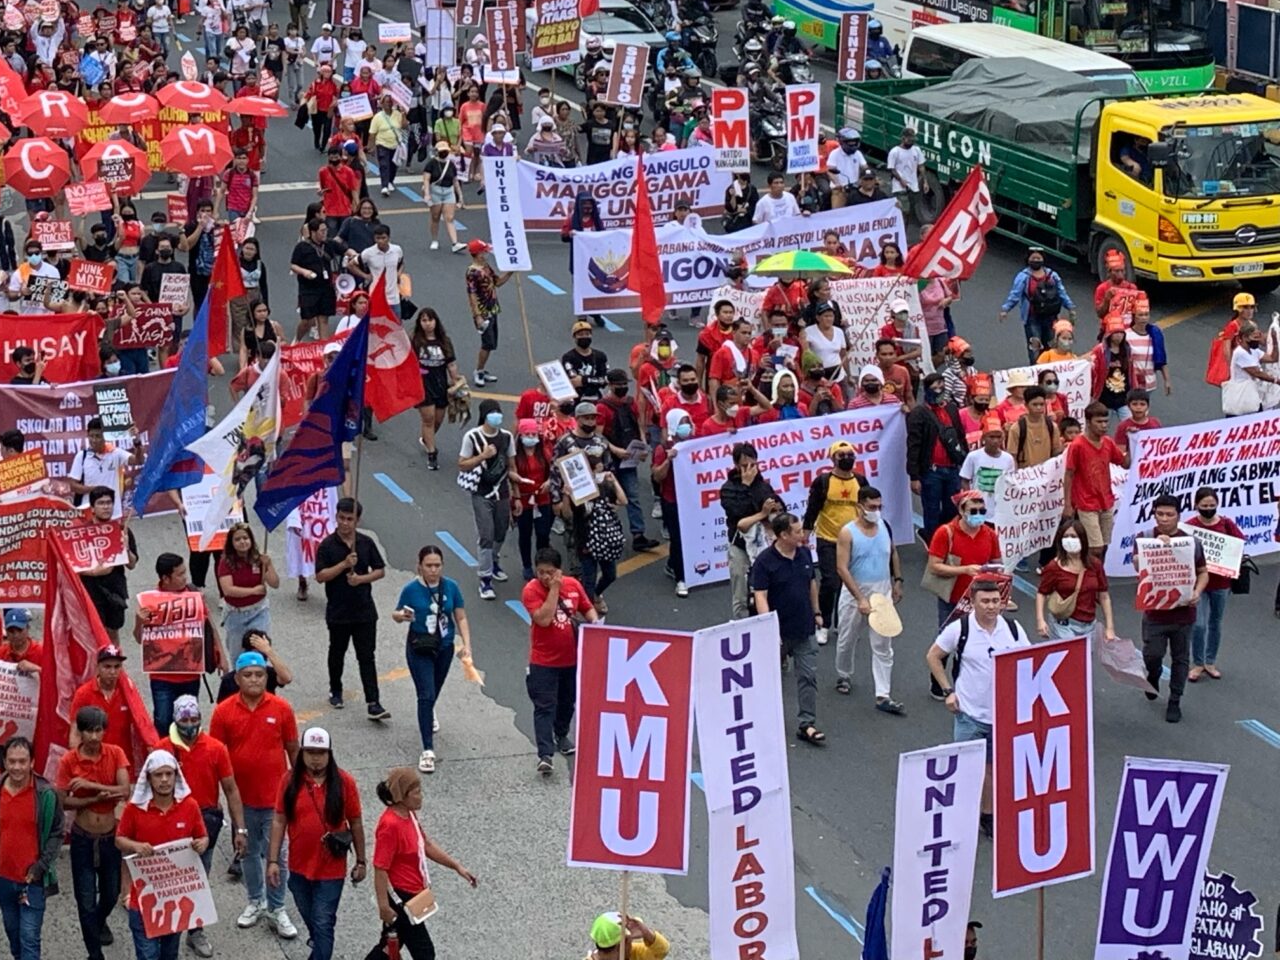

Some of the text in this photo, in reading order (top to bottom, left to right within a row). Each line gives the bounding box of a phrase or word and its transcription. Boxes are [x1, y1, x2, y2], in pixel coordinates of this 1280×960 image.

[494, 10, 508, 70] SENTRO
[536, 20, 579, 37] PRESYO
[542, 53, 571, 66] SENTRO
[846, 15, 860, 80] SENTRO
[622, 45, 638, 103] SENTRO
[39, 92, 70, 118] R
[178, 127, 216, 156] M
[903, 114, 992, 166] WILCON
[21, 141, 55, 179] C
[495, 161, 510, 212] UNITED
[535, 170, 557, 182] SA
[561, 171, 606, 183] SONA
[611, 166, 633, 181] NG
[35, 222, 59, 234] STOP
[778, 231, 815, 248] PRESYO!
[872, 216, 898, 231] ENDO!
[503, 221, 519, 266] LABOR
[75, 275, 107, 287] MDT!
[78, 263, 103, 276] JUNK
[4, 330, 87, 363] HSAY
[96, 388, 127, 401] MARCOS
[16, 417, 63, 434] ISKOLAR
[65, 415, 82, 432] NG
[810, 419, 885, 440] SA MGA
[1185, 429, 1222, 451] ANG
[1215, 448, 1234, 464] NG
[1197, 467, 1226, 487] ANG
[62, 524, 114, 540] DEFEND
[72, 536, 111, 563] UP
[5, 560, 48, 572] MARCO
[142, 627, 204, 641] NGAYON NA!
[720, 632, 762, 816] UNITED
[596, 637, 672, 857] KMU
[1012, 649, 1071, 874] KMU
[922, 755, 959, 928] UNITED
[1122, 778, 1209, 938] WWU
[731, 824, 767, 960] LABOR
[1229, 903, 1247, 921] at
